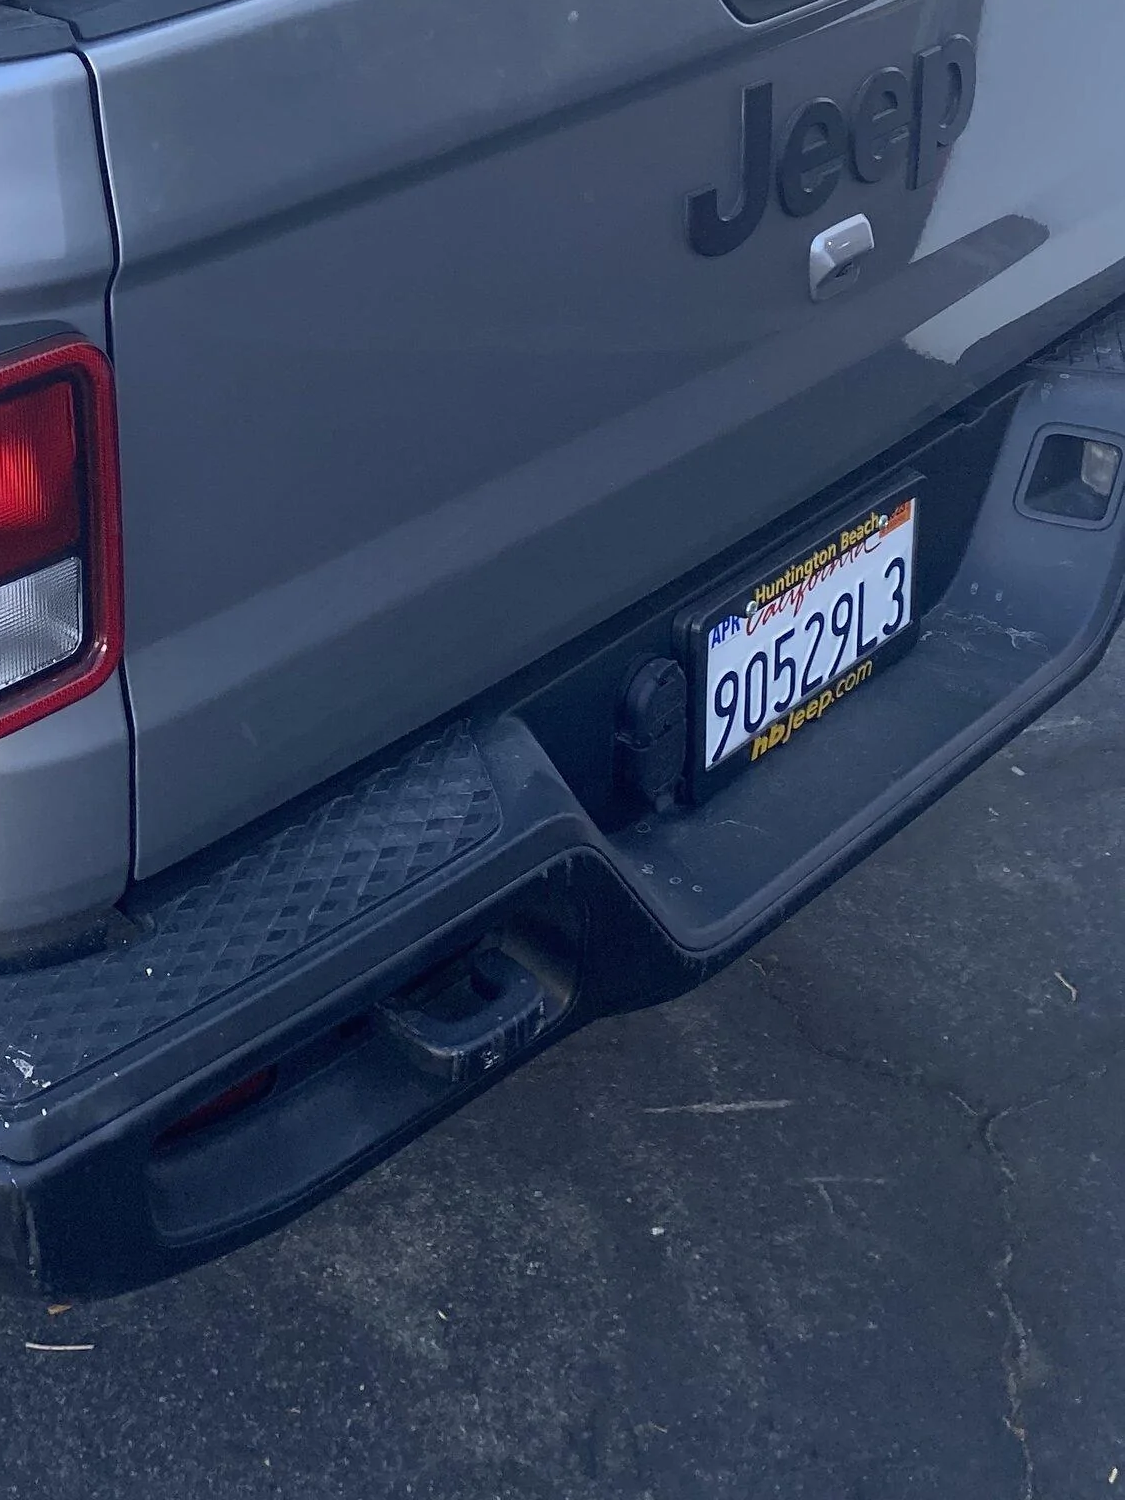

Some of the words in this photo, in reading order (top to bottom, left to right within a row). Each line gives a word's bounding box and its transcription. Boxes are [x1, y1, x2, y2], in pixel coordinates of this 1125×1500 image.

[684, 34, 976, 258] Jeep
[711, 614, 741, 649] APR
[754, 543, 837, 604] Huntington
[840, 512, 880, 551] Beach
[712, 556, 906, 763] 90529L3
